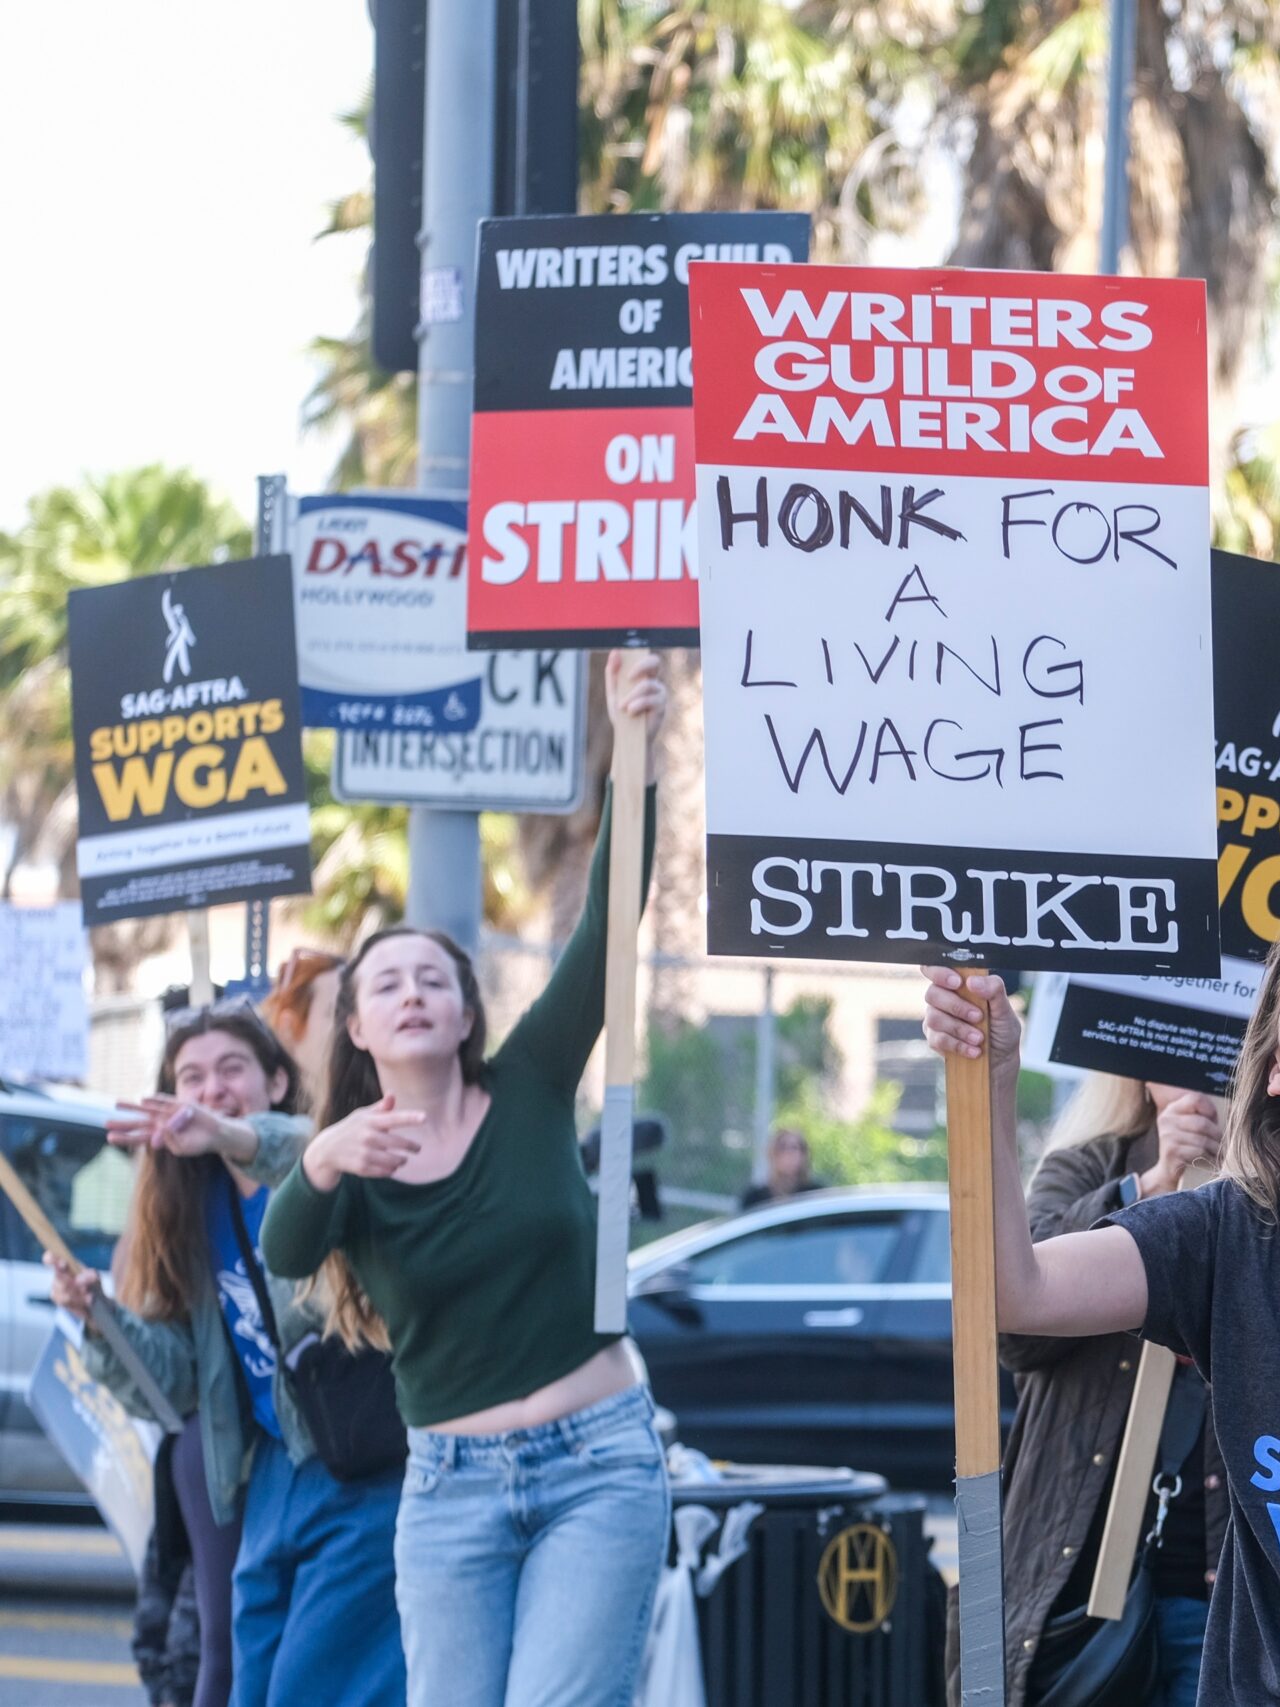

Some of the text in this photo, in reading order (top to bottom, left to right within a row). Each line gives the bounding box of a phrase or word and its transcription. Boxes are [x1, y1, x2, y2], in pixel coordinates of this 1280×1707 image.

[496, 244, 668, 290] WRITERS
[619, 299, 662, 334] OF
[739, 287, 1153, 353] WRITERS
[754, 340, 1135, 404] GUILD OF
[732, 393, 1166, 458] AMERICA
[604, 434, 676, 484] ON
[716, 475, 1178, 570] HONK FOR
[885, 564, 948, 622] A
[740, 629, 1084, 705] LIVING
[90, 698, 284, 761] SUPPORTS
[350, 729, 565, 776] INTERSECTION
[764, 713, 1064, 796] WAGE
[92, 736, 287, 822] WGA
[750, 856, 1180, 954] STRIKE
[1233, 980, 1257, 998] for
[1133, 1016, 1146, 1026] No
[1147, 1018, 1178, 1033] dispute
[1179, 1025, 1198, 1037] with
[1199, 1030, 1215, 1042] any
[1154, 1031, 1169, 1042] not
[1170, 1034, 1198, 1050] asking
[1199, 1041, 1215, 1053] any
